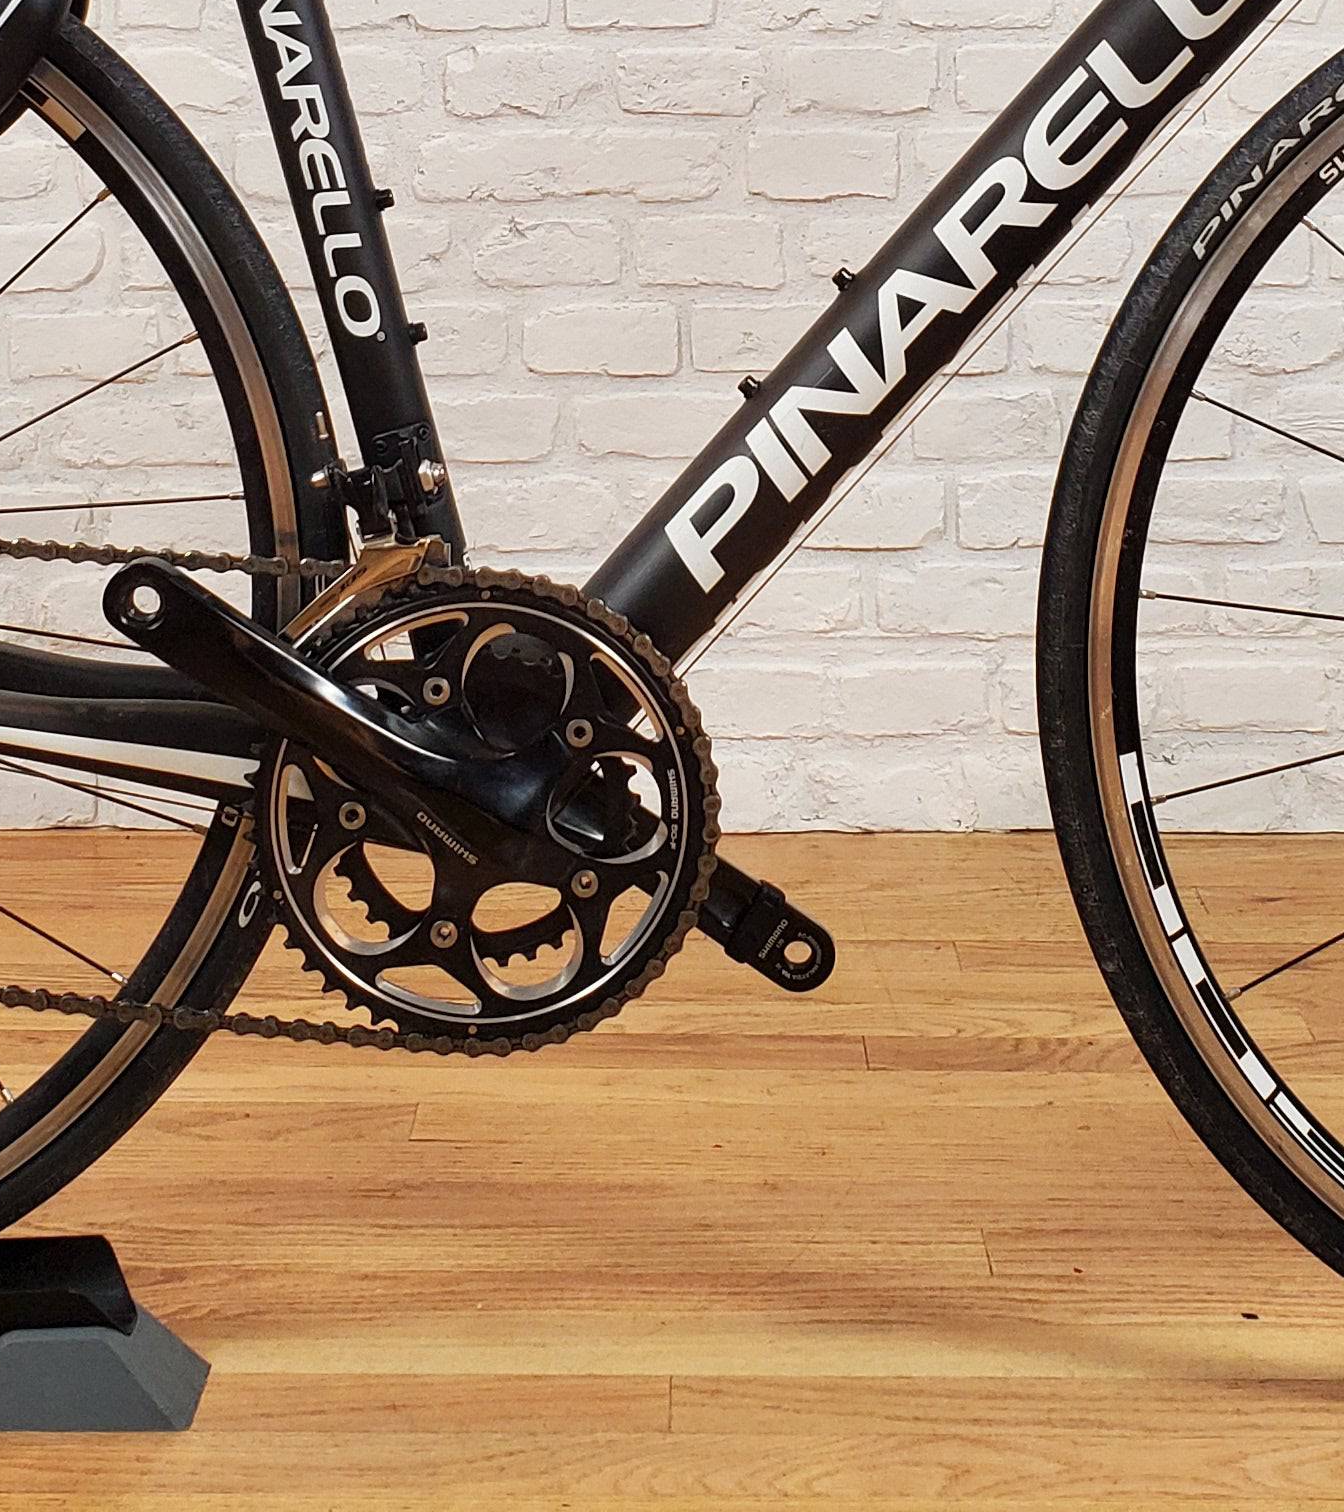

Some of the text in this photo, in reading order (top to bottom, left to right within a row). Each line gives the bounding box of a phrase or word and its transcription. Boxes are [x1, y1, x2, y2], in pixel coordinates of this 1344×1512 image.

[667, 768, 679, 820] SHIMANO
[416, 811, 479, 865] SHIMANO
[758, 918, 789, 959] SHIMANO
